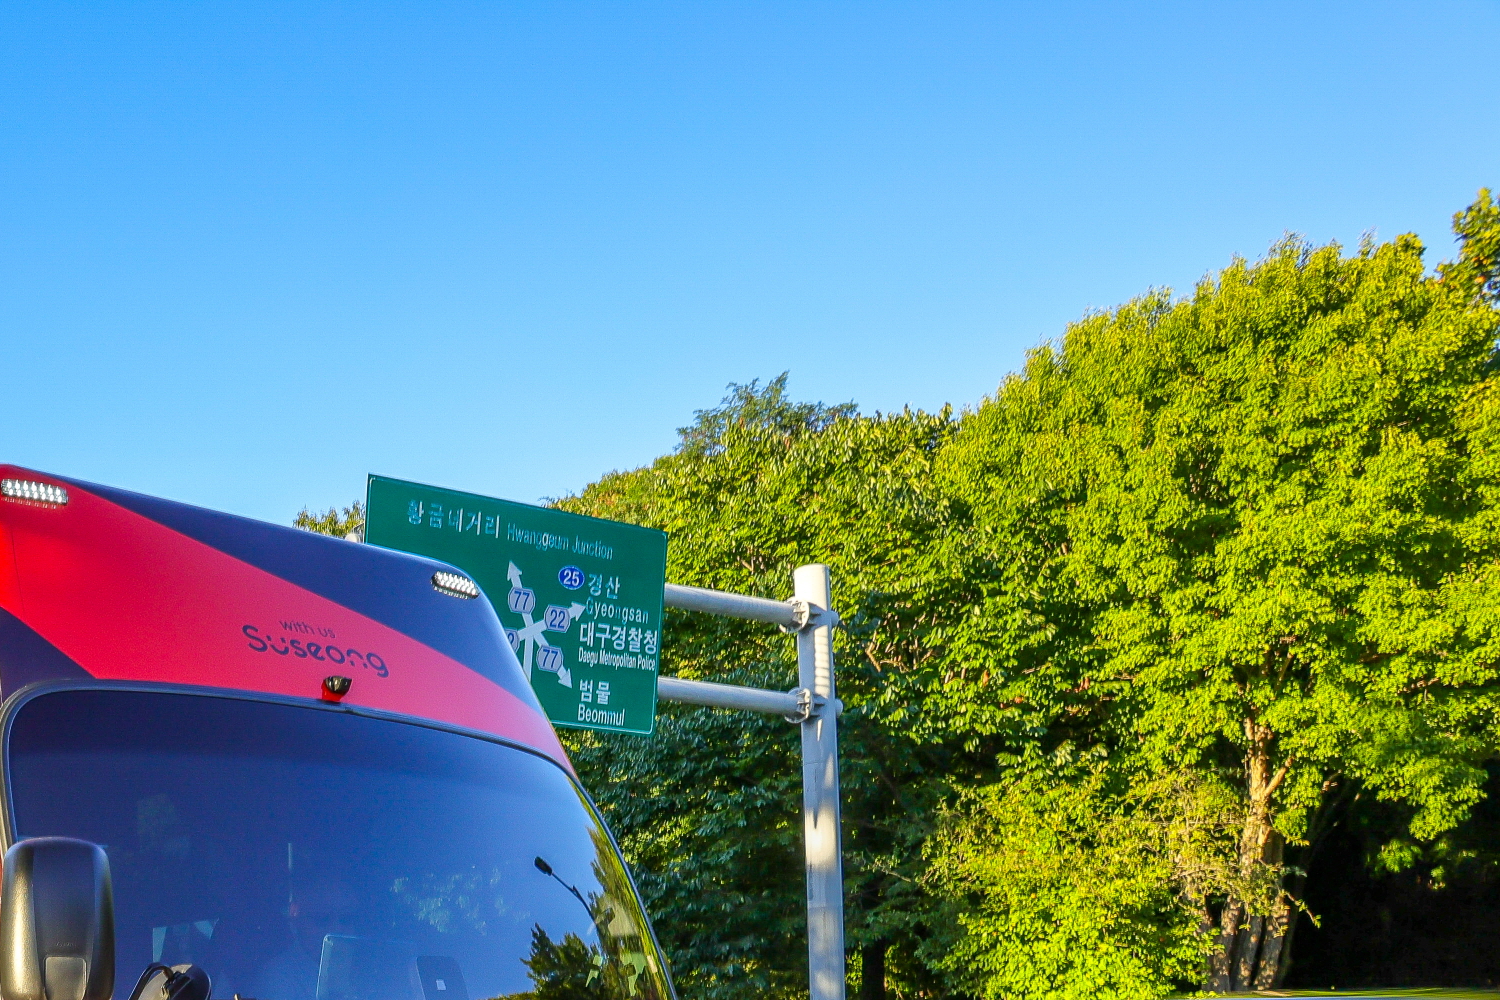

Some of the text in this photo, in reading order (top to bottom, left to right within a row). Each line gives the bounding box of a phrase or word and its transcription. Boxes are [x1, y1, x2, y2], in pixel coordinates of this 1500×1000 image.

[407, 499, 501, 538] 황금네거리
[507, 523, 613, 560] Hwanggeum Junction
[563, 570, 580, 587] 25
[588, 573, 621, 600] 경산
[513, 590, 530, 611] 77
[586, 596, 649, 624] Gyeongsan
[279, 620, 336, 639] with us
[549, 609, 566, 629] 22
[579, 622, 658, 655] 대구경찰청
[542, 648, 559, 668] 77
[578, 646, 656, 671] Daegu Metropolitan Police
[579, 679, 611, 705] 범물
[577, 703, 626, 727] Beommul
